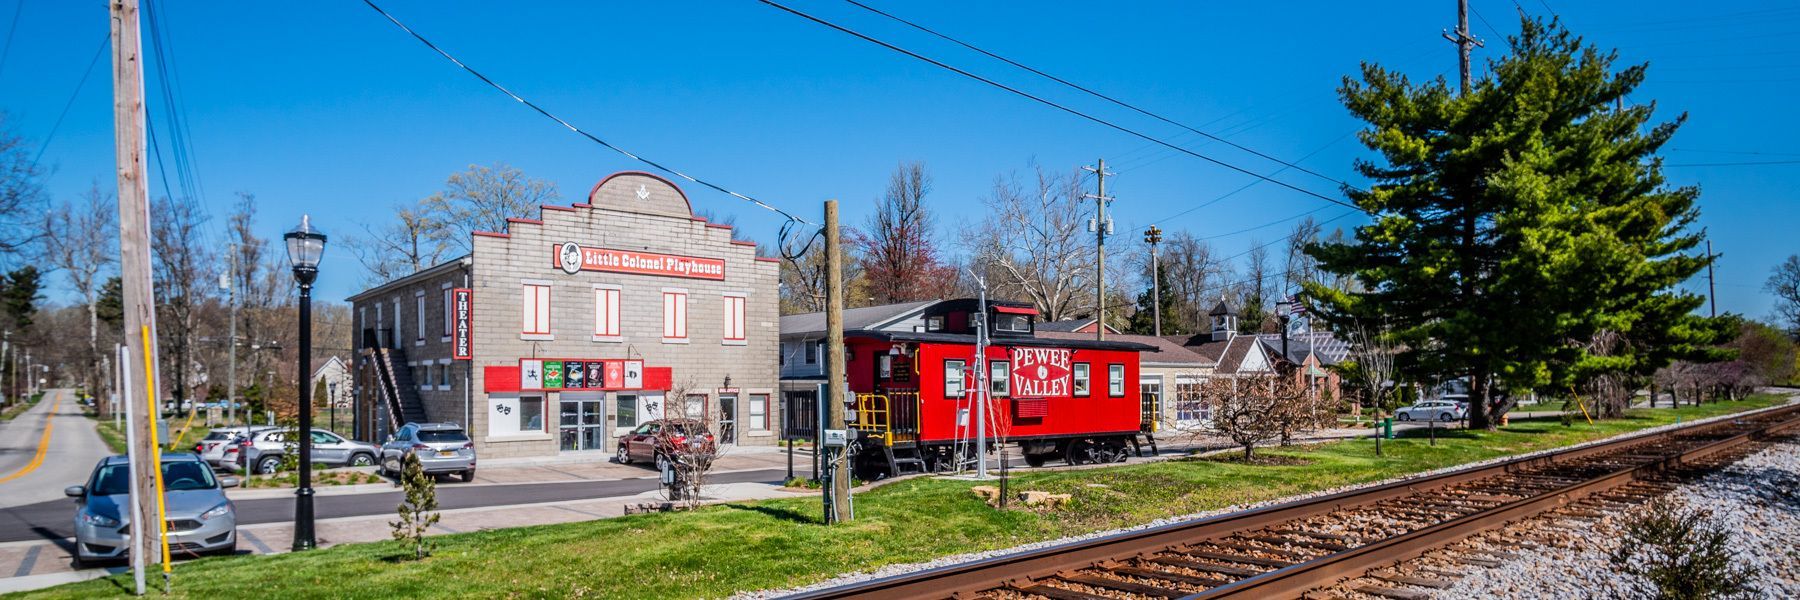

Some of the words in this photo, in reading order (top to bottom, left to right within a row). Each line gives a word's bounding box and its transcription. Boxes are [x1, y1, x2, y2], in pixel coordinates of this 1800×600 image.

[585, 250, 619, 267] Little
[622, 254, 664, 270] Colonel
[666, 257, 722, 275] Playhouse
[458, 292, 468, 356] THEATER
[1012, 347, 1070, 371] PEWEE
[1012, 372, 1070, 396] VALLEY
